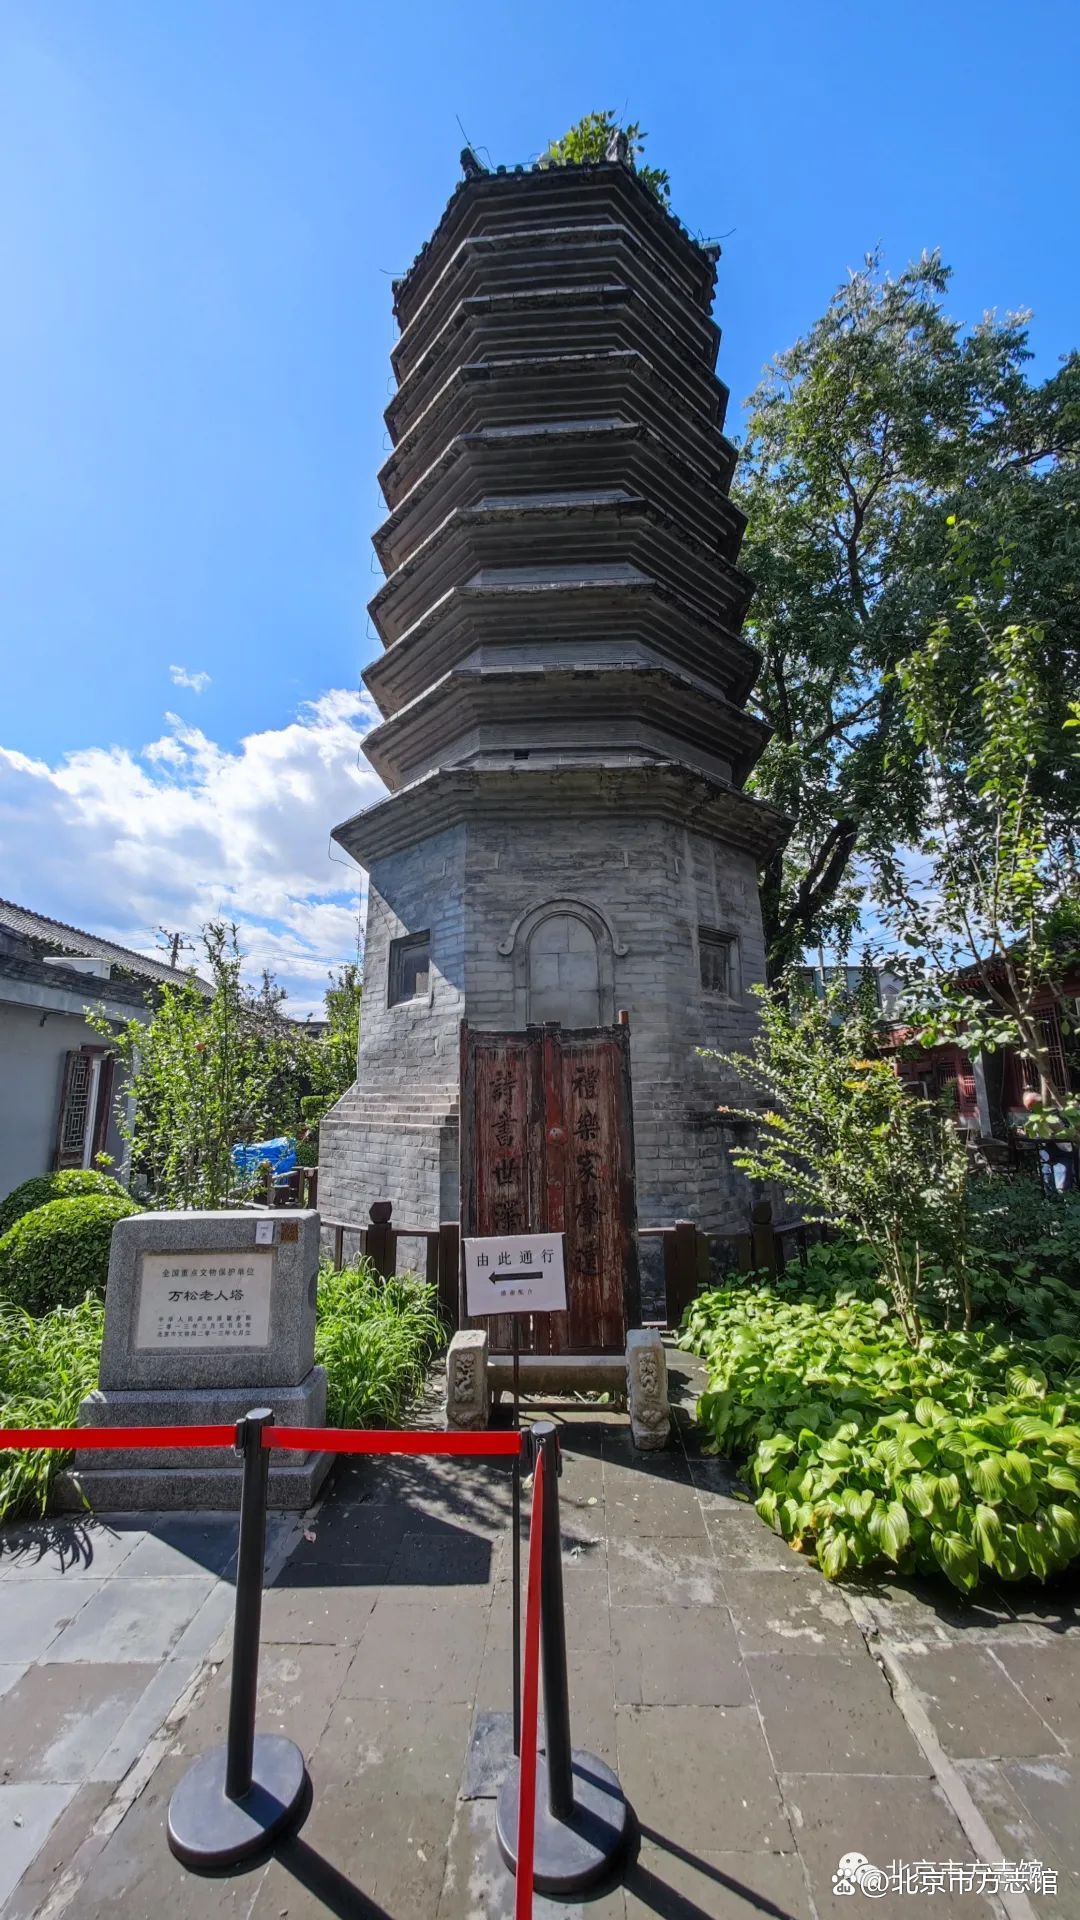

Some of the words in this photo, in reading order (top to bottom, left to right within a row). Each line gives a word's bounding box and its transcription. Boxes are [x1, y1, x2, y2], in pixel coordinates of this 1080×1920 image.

[477, 1248, 554, 1267] 由此通行
[162, 1268, 255, 1278] 全国重点文物保护单位
[168, 1289, 244, 1302] 万松老人塔
